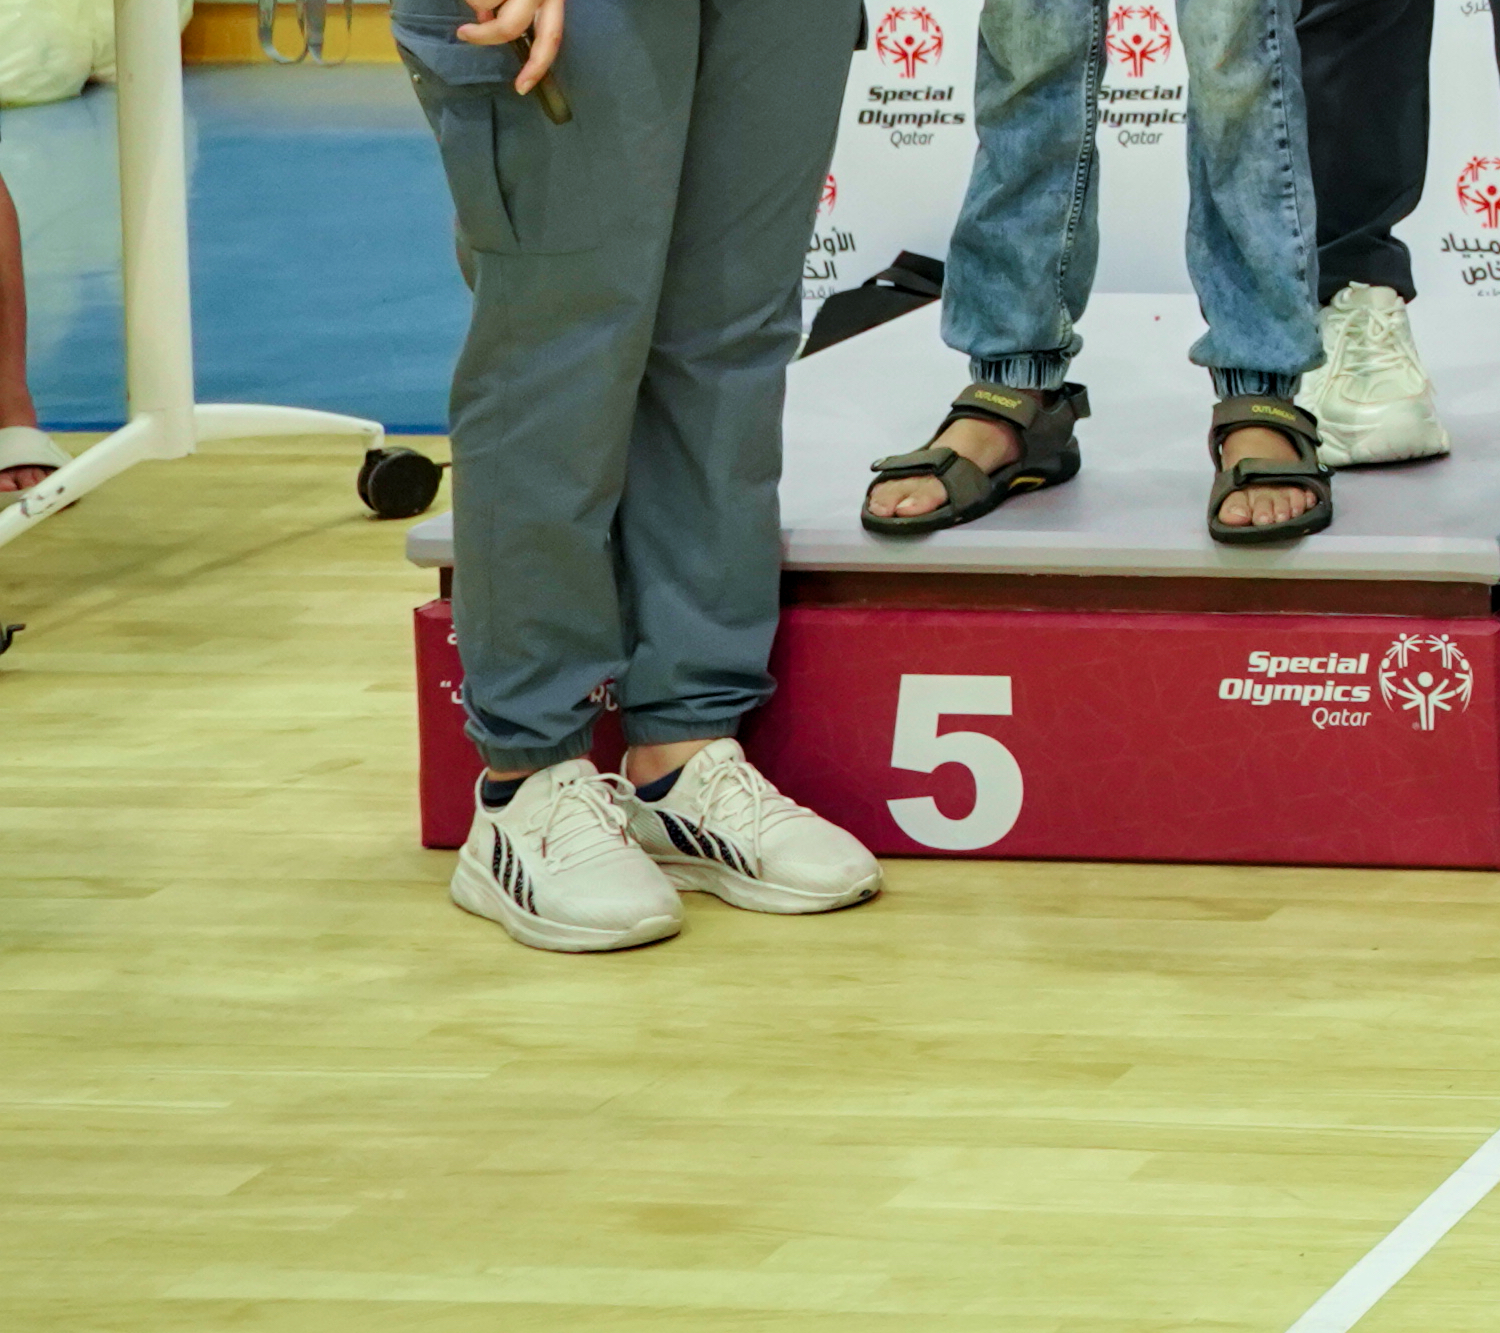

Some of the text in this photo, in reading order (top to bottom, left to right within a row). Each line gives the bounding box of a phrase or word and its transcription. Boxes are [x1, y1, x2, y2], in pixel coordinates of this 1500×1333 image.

[868, 86, 954, 105] Special
[1099, 86, 1183, 105] Special
[858, 109, 965, 128] Olympics
[889, 129, 935, 149] Qatar
[1117, 129, 1163, 148] Qatar
[1247, 651, 1370, 678] Special
[1218, 678, 1372, 707] Olympics
[1311, 707, 1372, 730] Qatar
[887, 674, 1023, 850] 5
